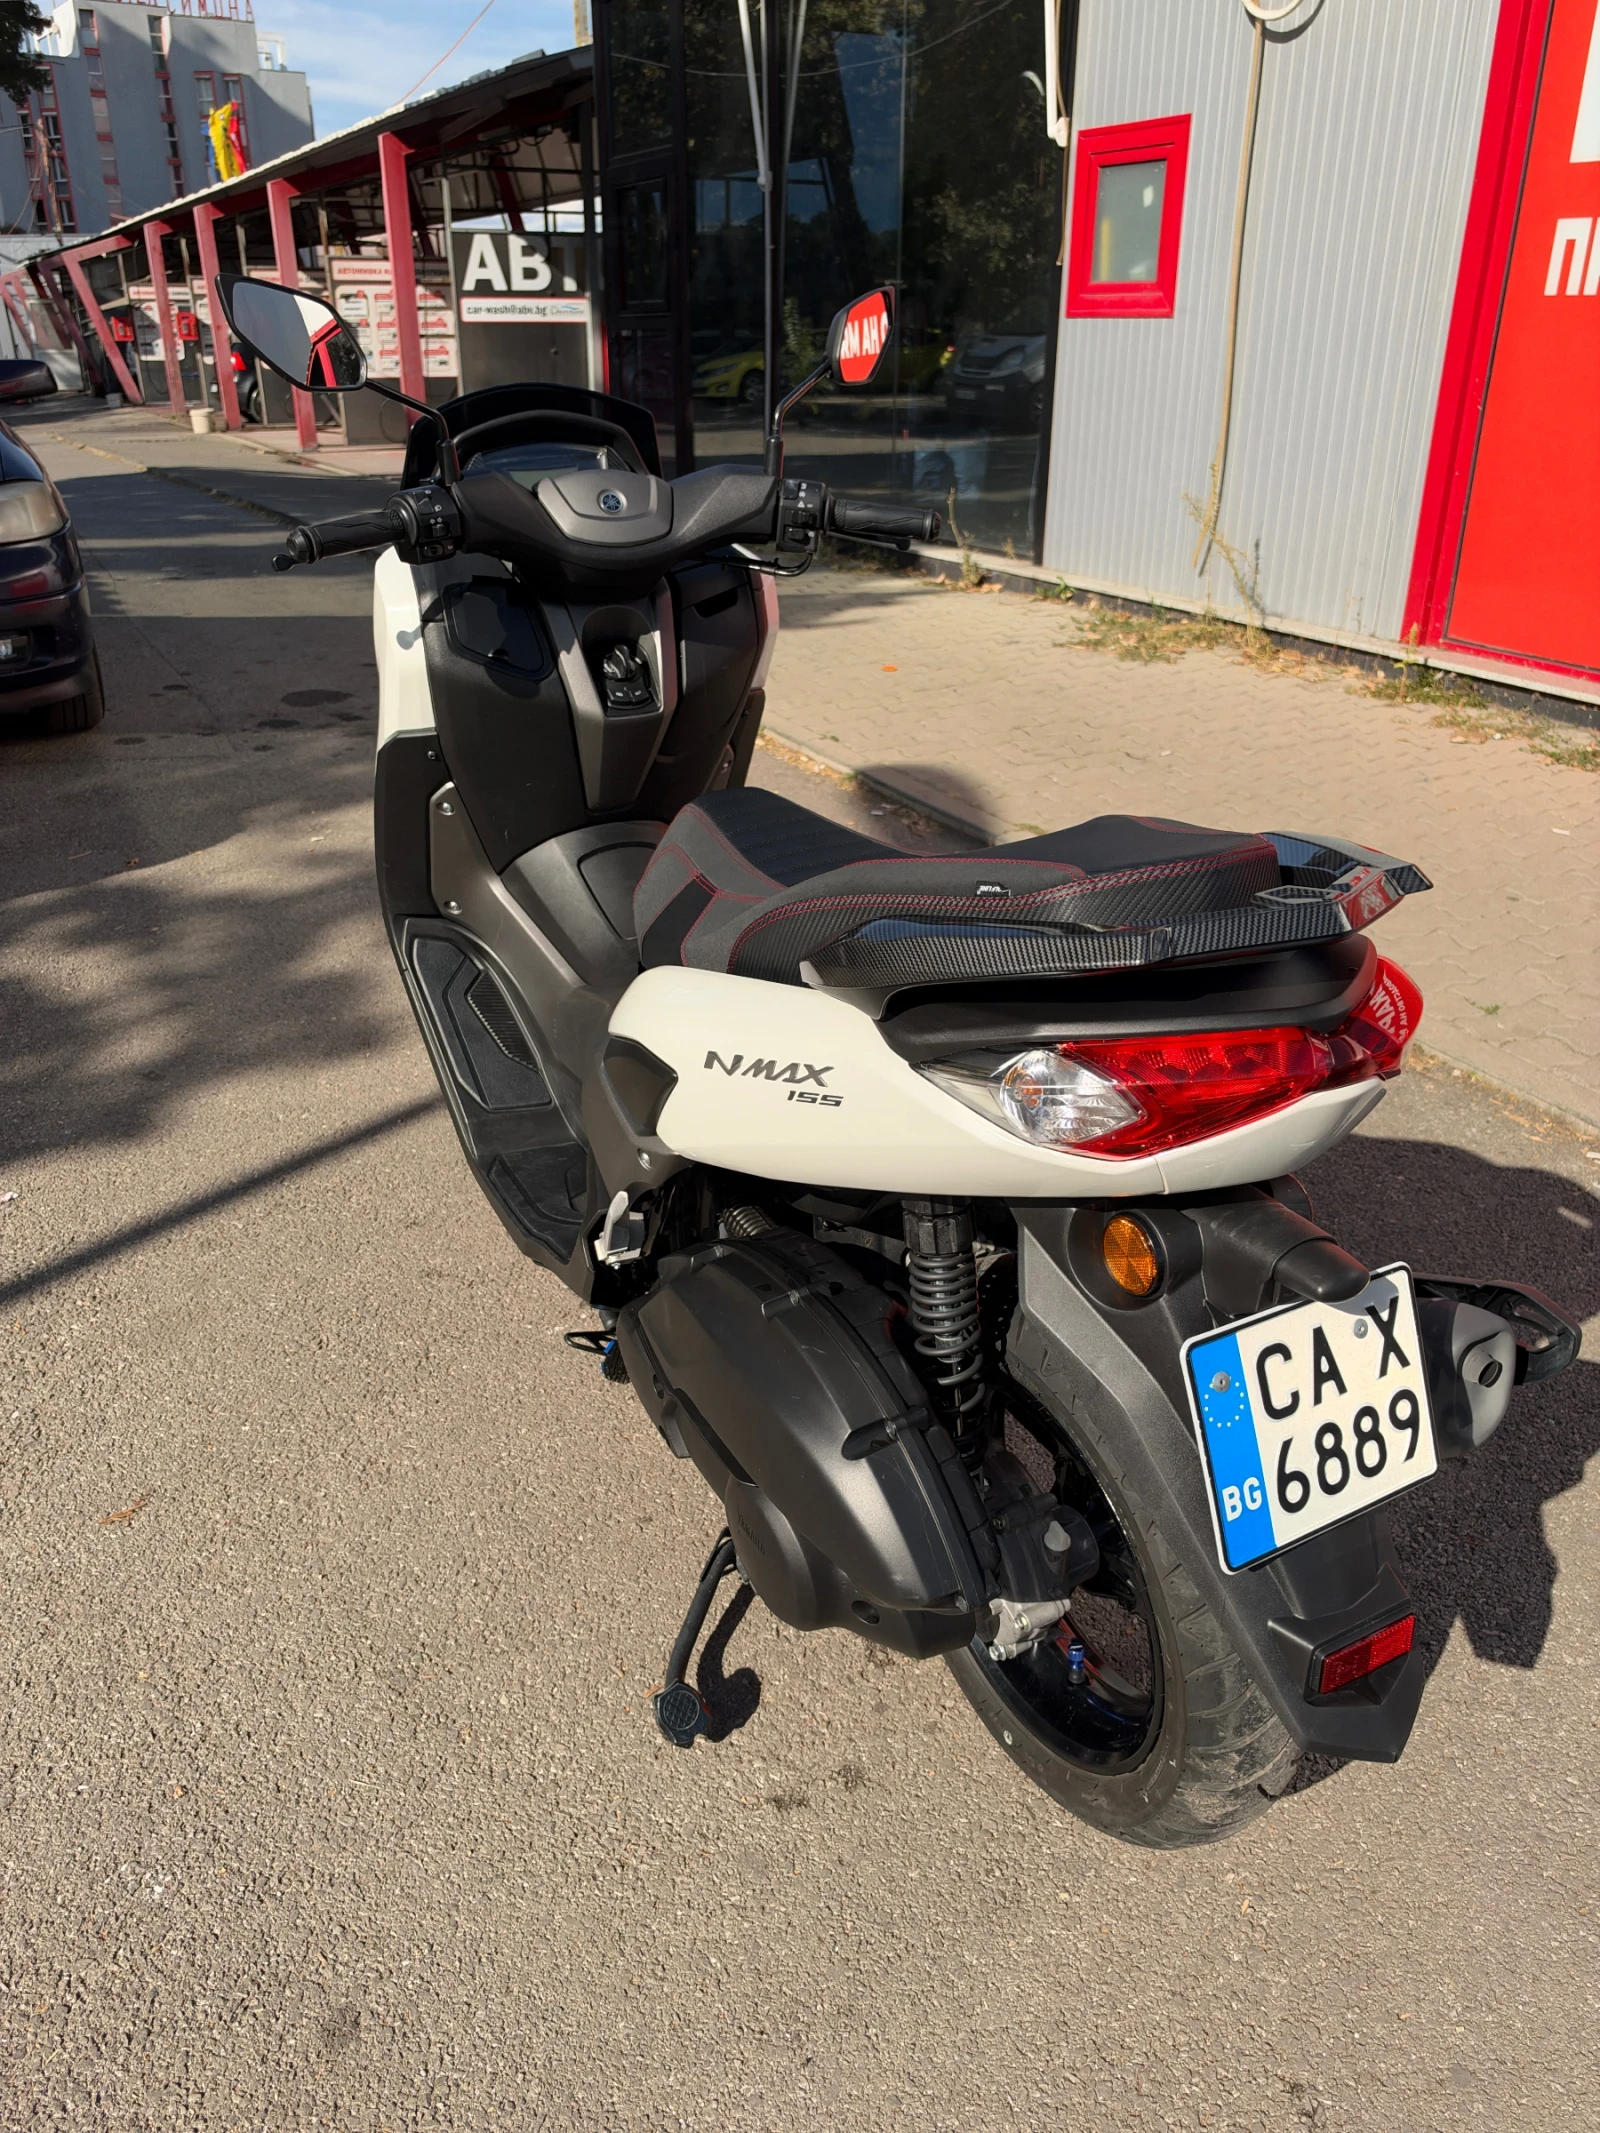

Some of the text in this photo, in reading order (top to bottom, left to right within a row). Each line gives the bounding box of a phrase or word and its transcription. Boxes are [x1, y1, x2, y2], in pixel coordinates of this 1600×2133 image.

[703, 1050, 835, 1088] NMAX
[787, 1090, 844, 1107] 155
[1255, 1295, 1412, 1422] CA X
[1276, 1388, 1421, 1515] 6889
[1221, 1476, 1264, 1523] BG
